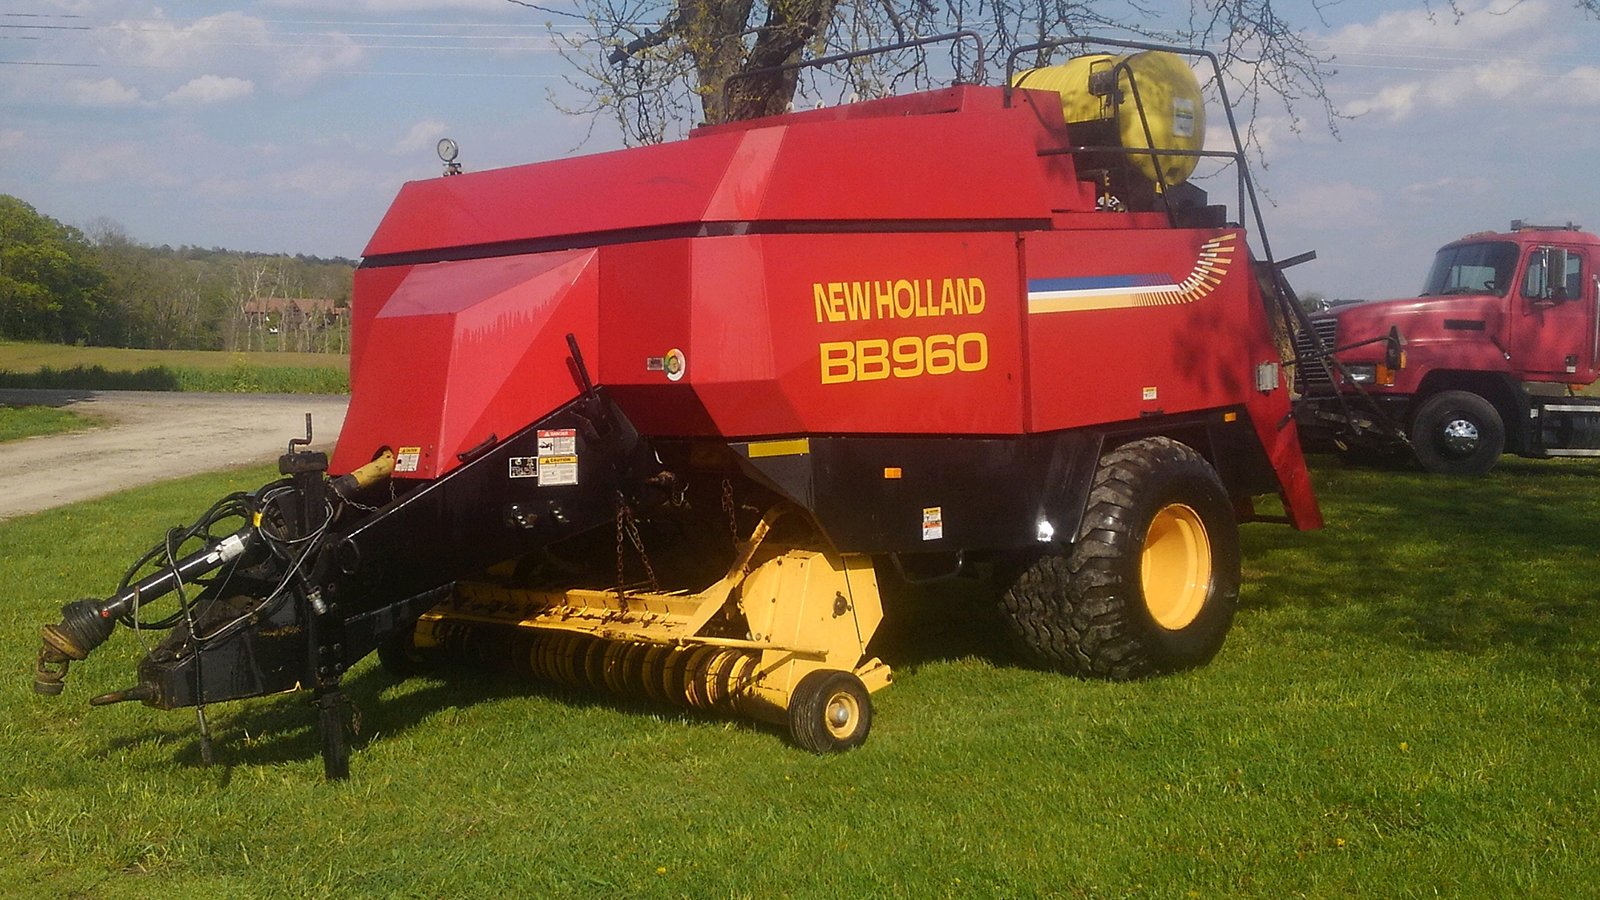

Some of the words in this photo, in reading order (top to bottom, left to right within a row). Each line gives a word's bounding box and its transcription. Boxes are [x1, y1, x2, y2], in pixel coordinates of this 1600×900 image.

[813, 281, 870, 323] NEW
[874, 278, 986, 319] HOLLAND
[820, 332, 988, 385] BB960
